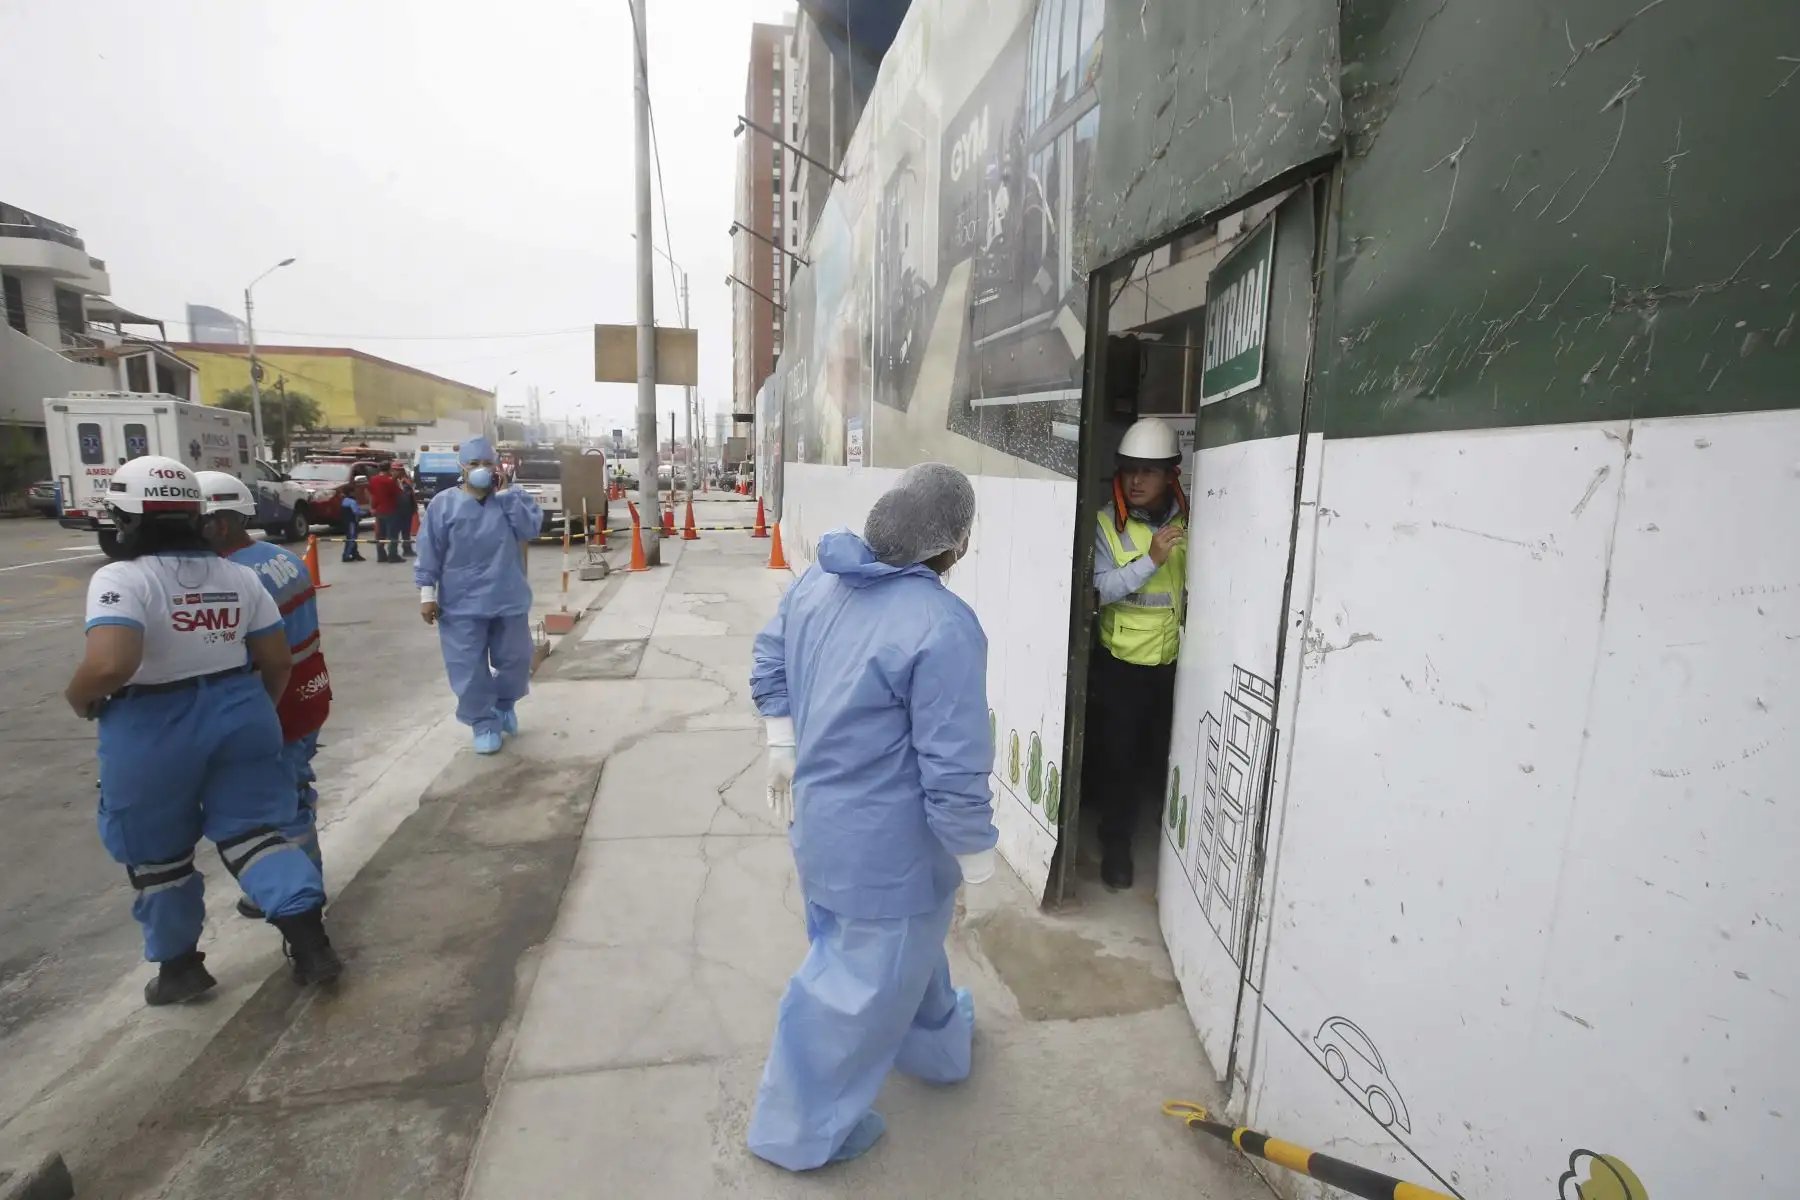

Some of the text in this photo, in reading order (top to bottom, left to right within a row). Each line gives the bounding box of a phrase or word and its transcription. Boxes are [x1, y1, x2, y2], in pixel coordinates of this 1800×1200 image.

[951, 104, 989, 181] GYM
[1205, 259, 1264, 372] ENTRADA
[86, 468, 117, 476] AMBU
[154, 469, 186, 480] 106
[144, 485, 200, 498] MÉDICO
[171, 607, 240, 631] SAMU
